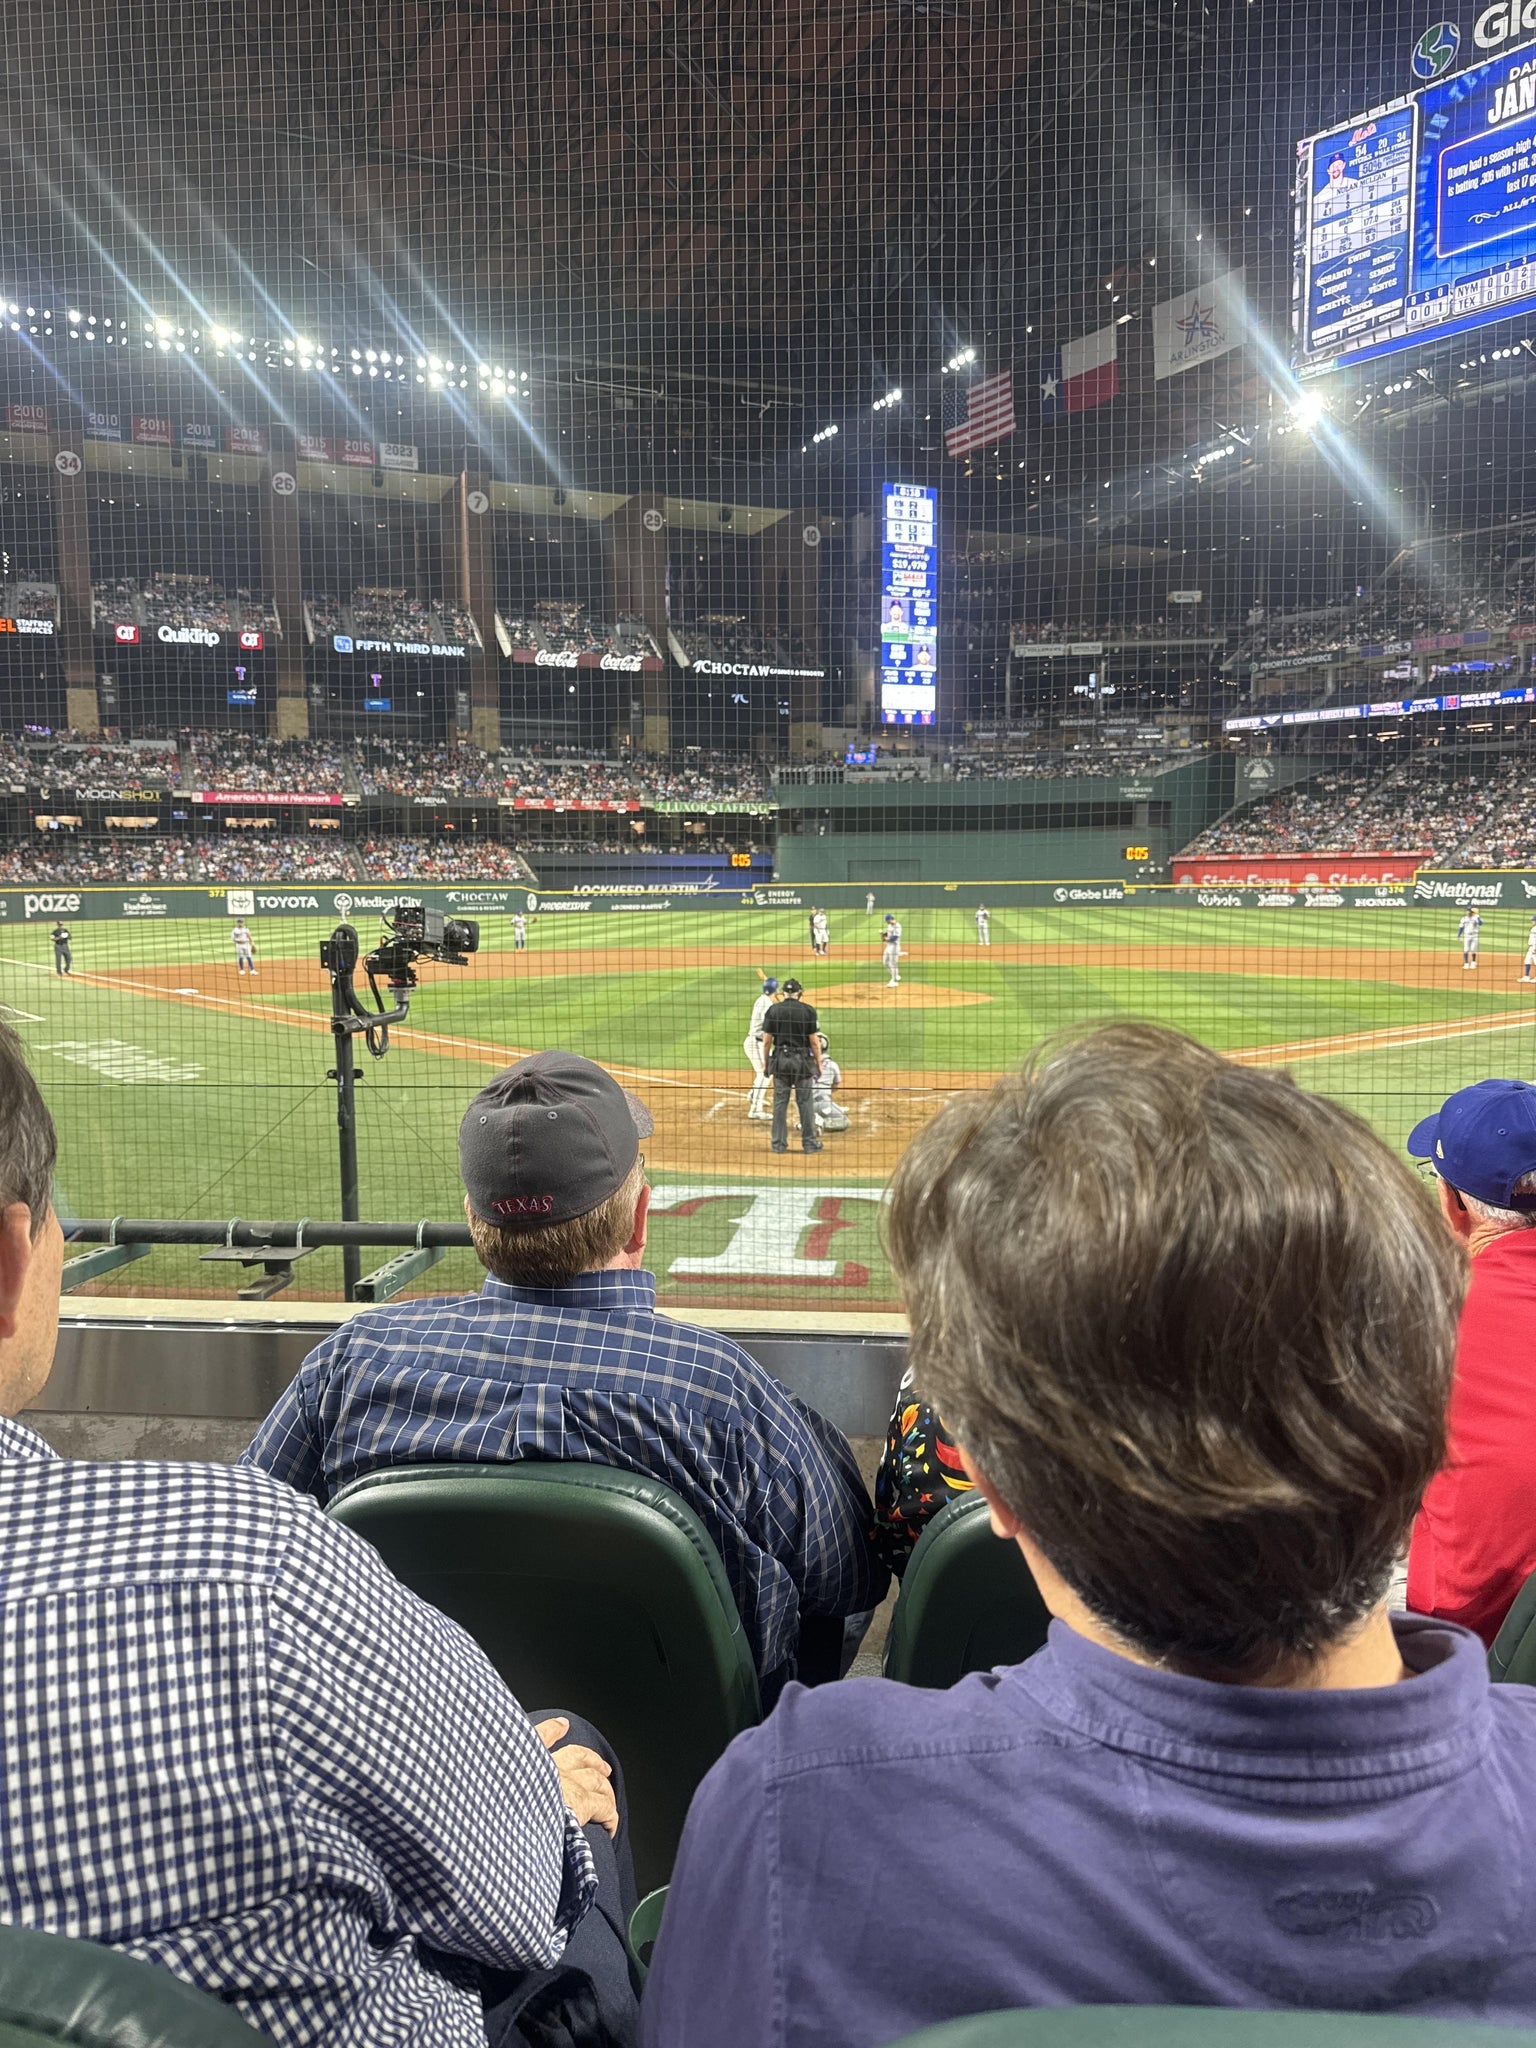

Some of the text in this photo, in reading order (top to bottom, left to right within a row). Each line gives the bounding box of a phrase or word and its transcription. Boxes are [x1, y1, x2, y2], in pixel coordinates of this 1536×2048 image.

[1356, 130, 1407, 158] 54 20 34
[1447, 164, 1468, 180] Danny
[1469, 156, 1482, 172] had
[1489, 138, 1532, 164] season-high
[1337, 172, 1387, 196] NOLAN MCLEAN
[1455, 177, 1479, 195] batting
[1495, 164, 1511, 179] with
[1457, 267, 1527, 297] NYM 0 0 2
[1459, 280, 1526, 309] TEX 0 0 0
[1411, 310, 1416, 321] 0
[1424, 305, 1430, 316] 0
[1170, 333, 1226, 365] ARLINGTON
[14, 404, 44, 418] 2010
[89, 412, 118, 426] 2010
[140, 418, 166, 431] 2011
[186, 423, 211, 436] 2011
[345, 440, 371, 452] 2016
[384, 444, 412, 457] 2023
[59, 455, 78, 472] 34
[274, 476, 293, 491] 26
[474, 496, 482, 510] 7
[646, 513, 662, 528] 29
[806, 529, 817, 543] 10
[116, 626, 136, 641] QT
[157, 625, 220, 647] QuikTrip
[240, 632, 260, 648] QT
[356, 638, 466, 657] FIFTH THIRD BANK
[1383, 641, 1412, 655] 105.3
[1260, 653, 1333, 669] PRIORITY COMMERCE
[700, 660, 770, 678] CHOCTAW
[75, 789, 161, 800] MOONSHOT
[215, 792, 331, 804] America's Best Network
[413, 796, 447, 804] ARENA
[665, 802, 769, 813] LUXOR STAFFING
[732, 854, 751, 867] 0:05
[1126, 847, 1149, 860] 0:05
[573, 885, 699, 897] LOCKHEED MARTIN
[768, 890, 795, 898] ENERGY
[1069, 888, 1124, 900] Globe Life
[1388, 886, 1405, 894] 374
[1432, 881, 1503, 898] National
[257, 896, 319, 909] TOYOTA
[354, 895, 423, 908] Medical City
[453, 892, 508, 903] CHOCTAW
[768, 897, 802, 905] TRANSFER
[1197, 893, 1242, 907] Kubota
[1354, 898, 1407, 907] HONDA
[1455, 898, 1498, 906] Car Rental
[24, 893, 81, 919] paze
[538, 901, 591, 911] PROGRESSIVE
[491, 1195, 554, 1217] TEXAS
